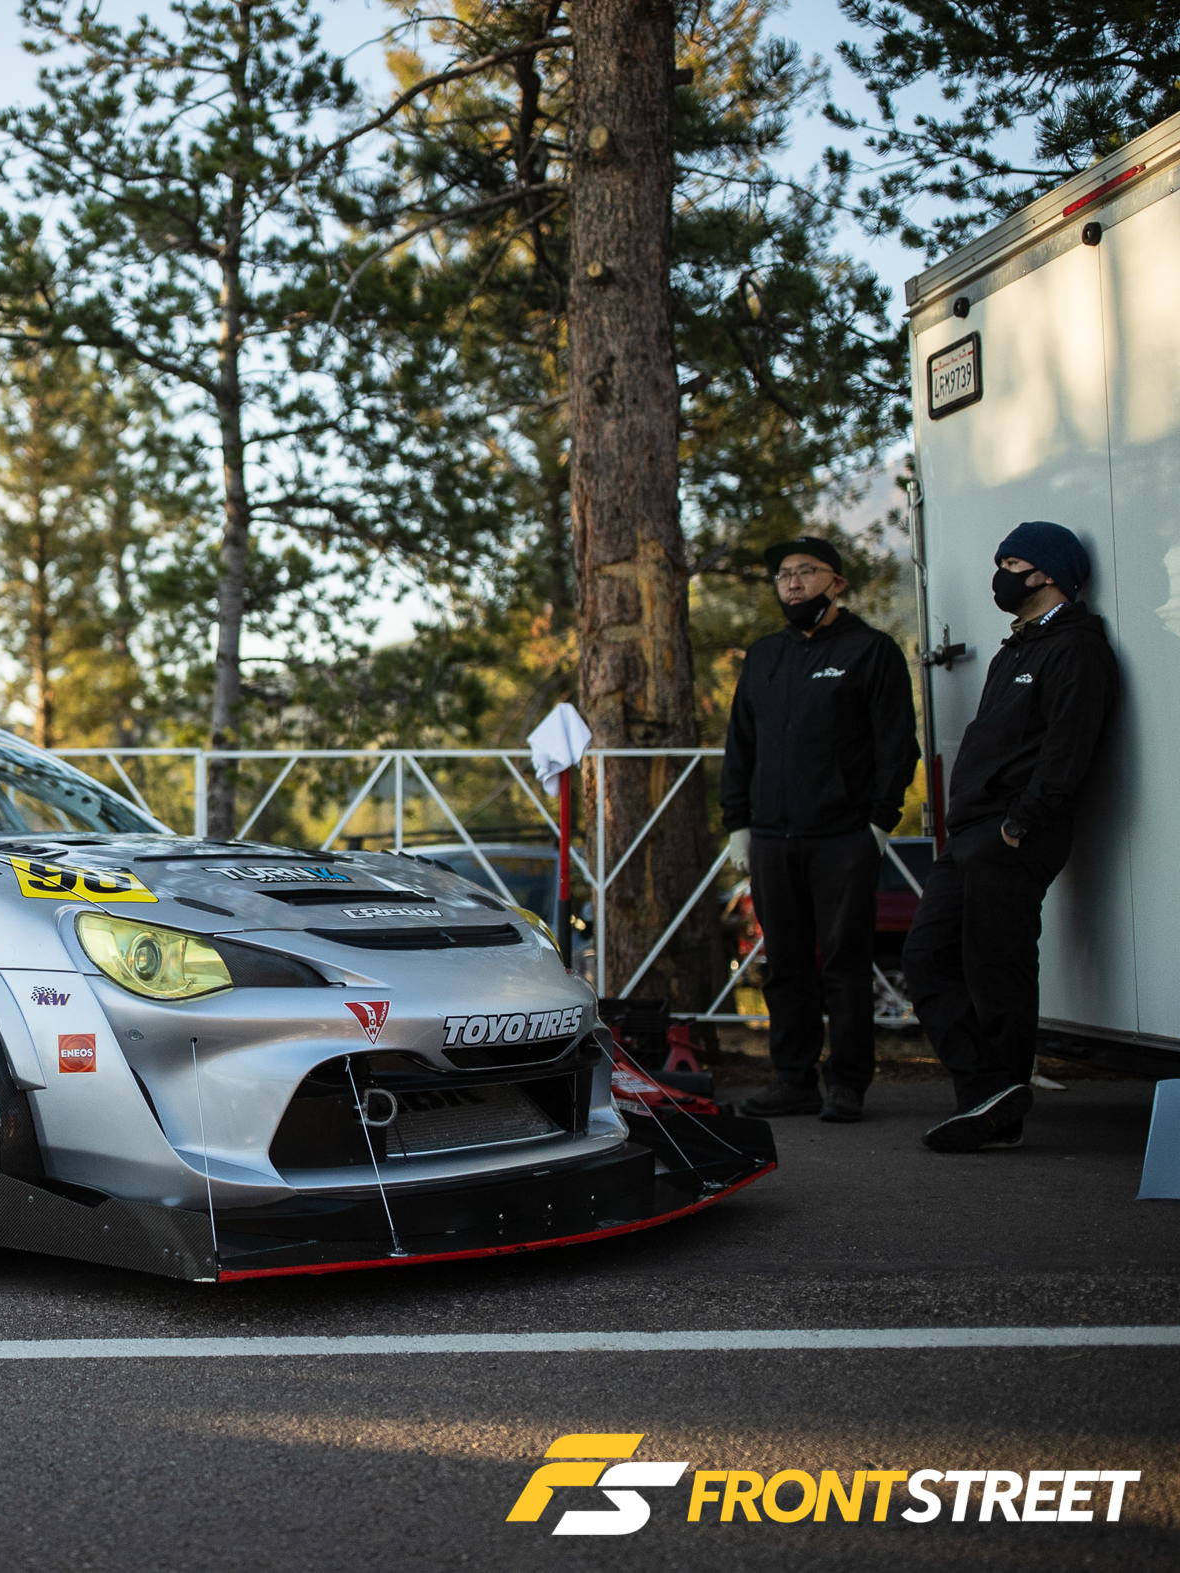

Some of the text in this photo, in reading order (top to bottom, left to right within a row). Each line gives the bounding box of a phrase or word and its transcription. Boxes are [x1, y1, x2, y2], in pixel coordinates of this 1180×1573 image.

[37, 993, 70, 1006] KW
[368, 1010, 377, 1035] TOW
[445, 1007, 583, 1045] TOYO TIRES
[61, 1049, 93, 1058] ENEOS
